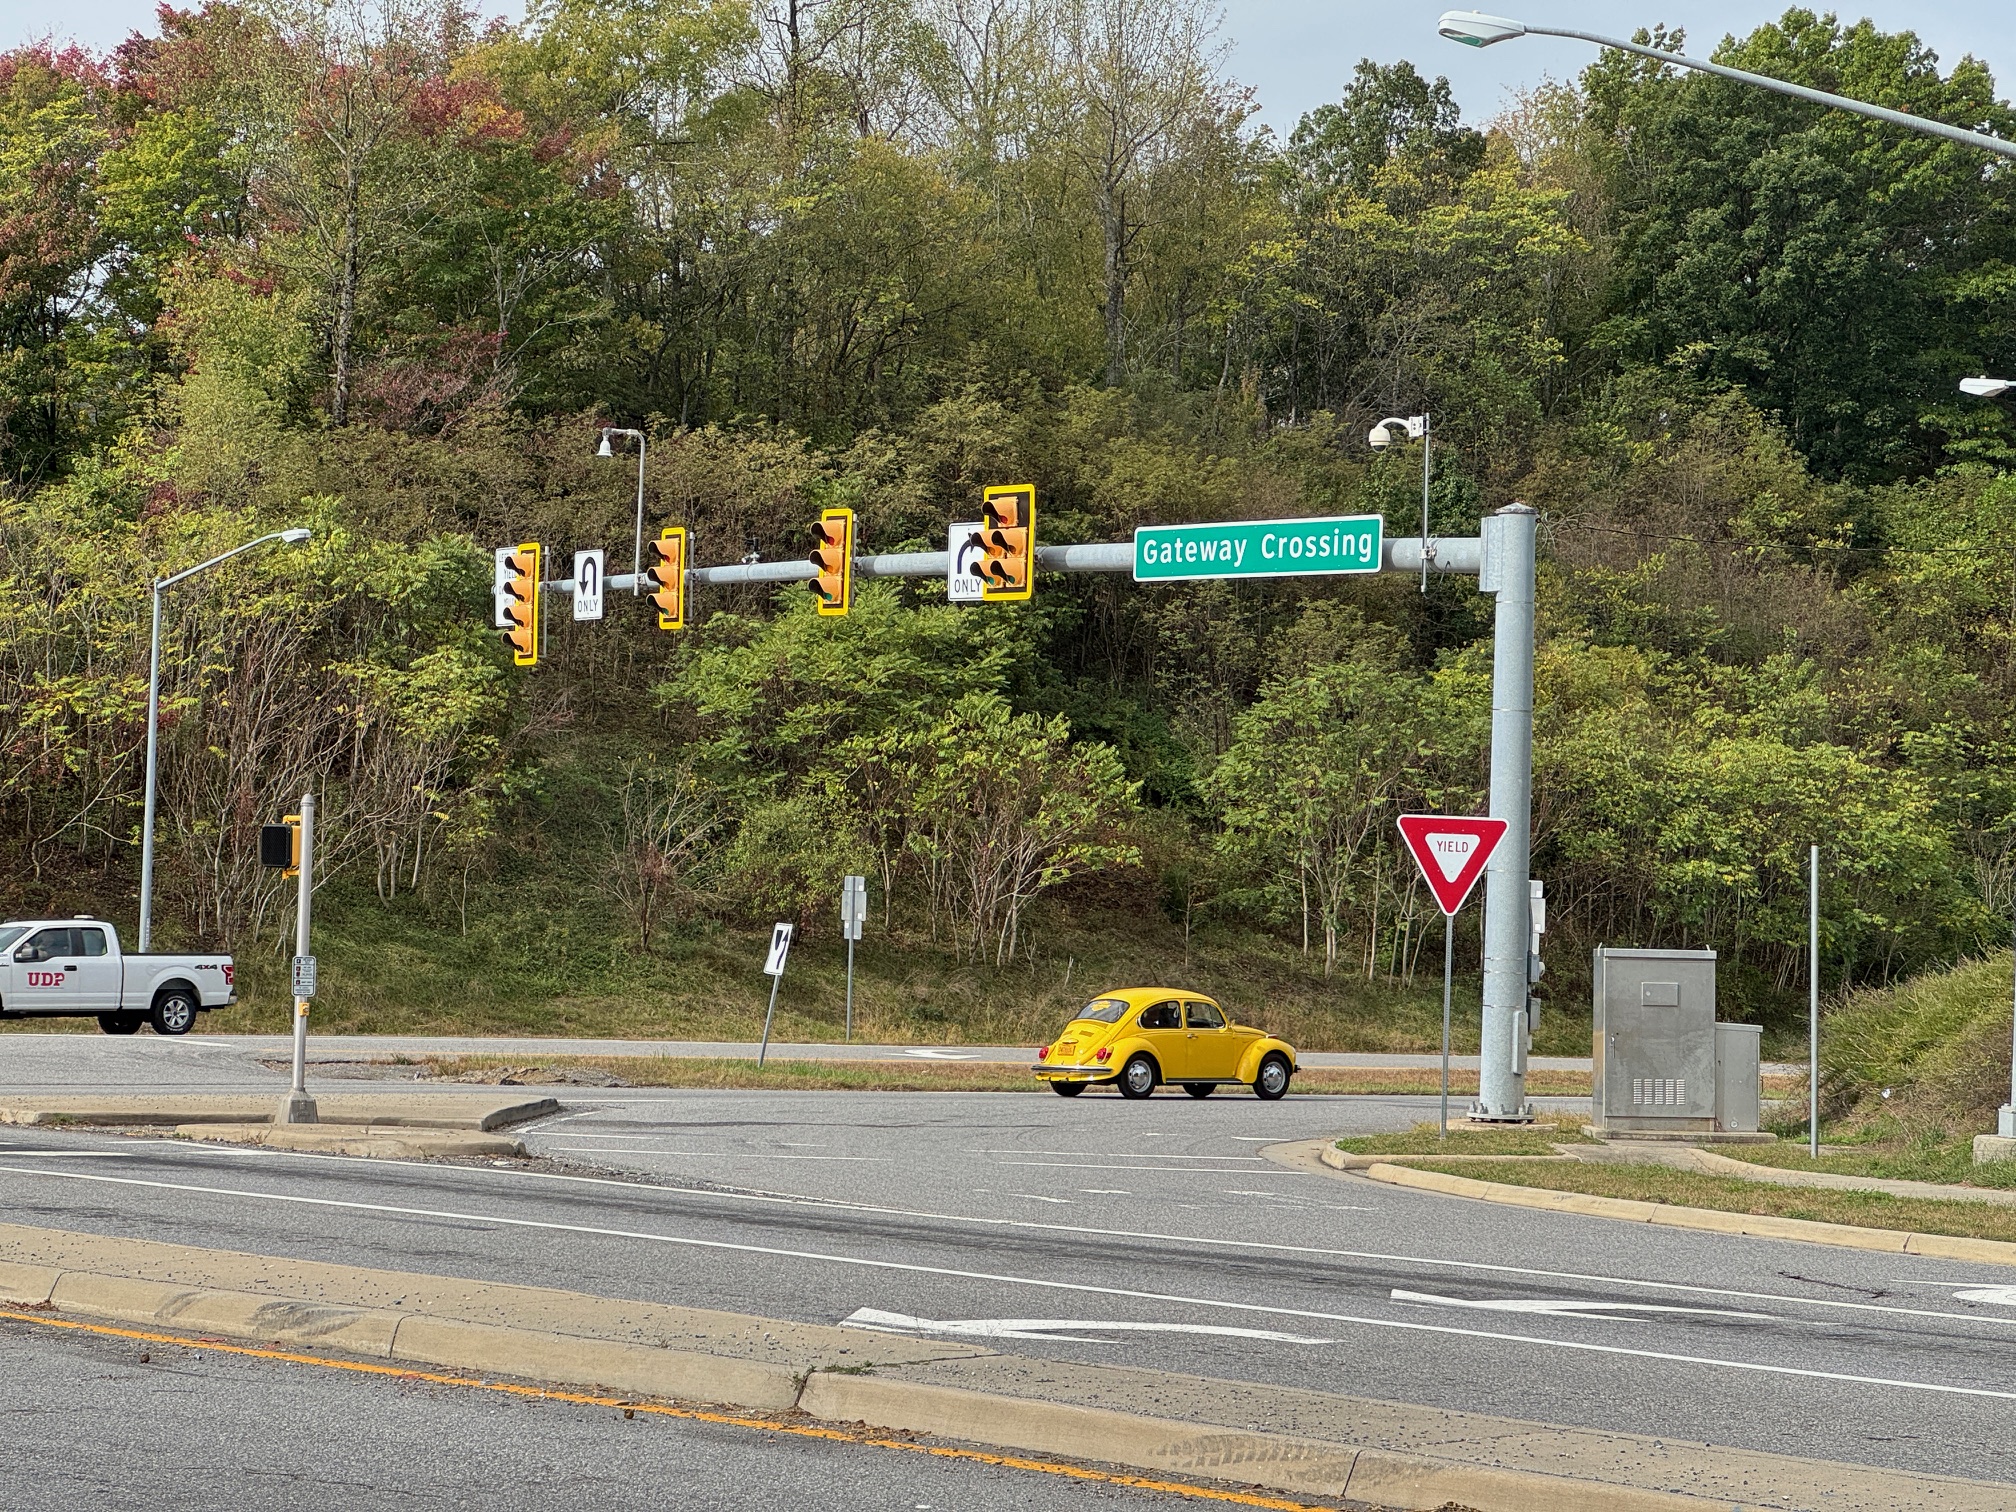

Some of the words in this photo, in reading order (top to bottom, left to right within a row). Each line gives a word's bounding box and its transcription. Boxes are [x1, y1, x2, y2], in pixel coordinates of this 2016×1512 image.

[1143, 537, 1247, 568] Gateway
[1261, 528, 1373, 563] Crossing
[954, 578, 982, 593] ONLY
[577, 598, 599, 613] ONLY
[1436, 840, 1469, 853] YIELD
[27, 972, 66, 986] UDP
